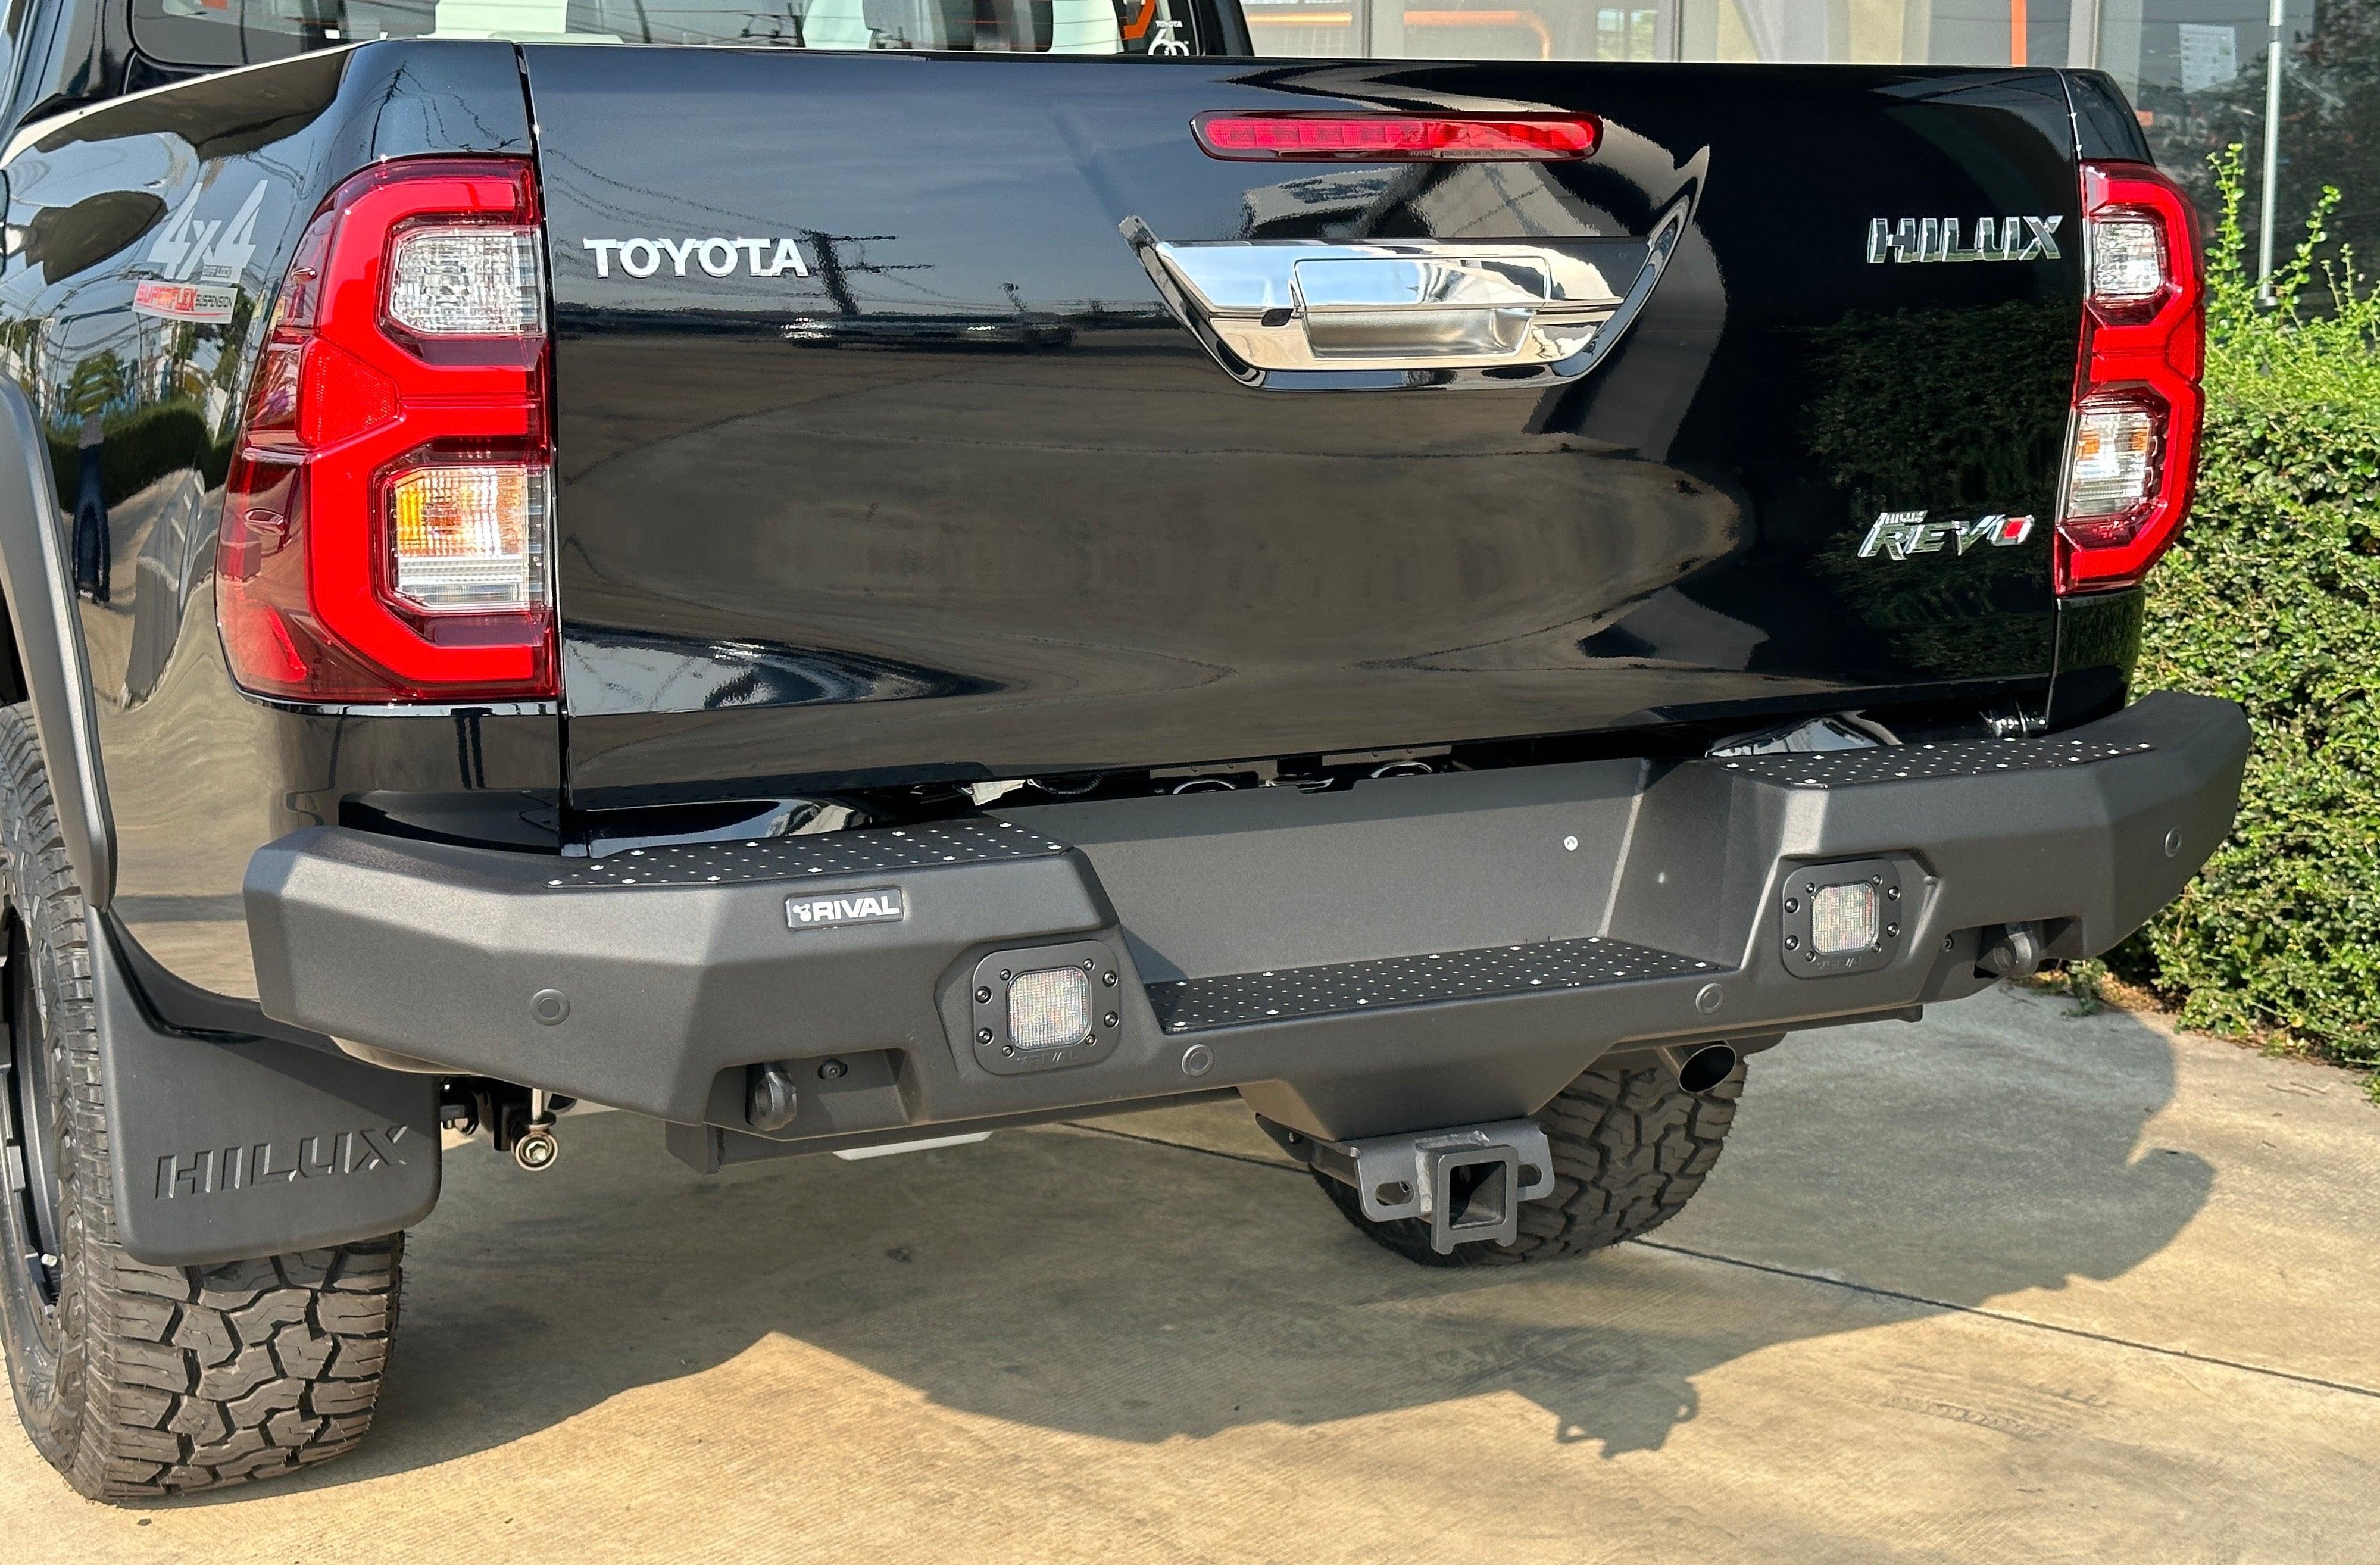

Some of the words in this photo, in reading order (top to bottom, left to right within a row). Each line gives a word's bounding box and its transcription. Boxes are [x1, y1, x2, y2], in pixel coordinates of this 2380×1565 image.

[583, 236, 808, 278] TOYOTA
[1867, 215, 2063, 263] HILUX
[1857, 514, 2034, 560] REVO
[812, 896, 900, 921] RIVAL
[155, 1124, 409, 1199] HILUX
